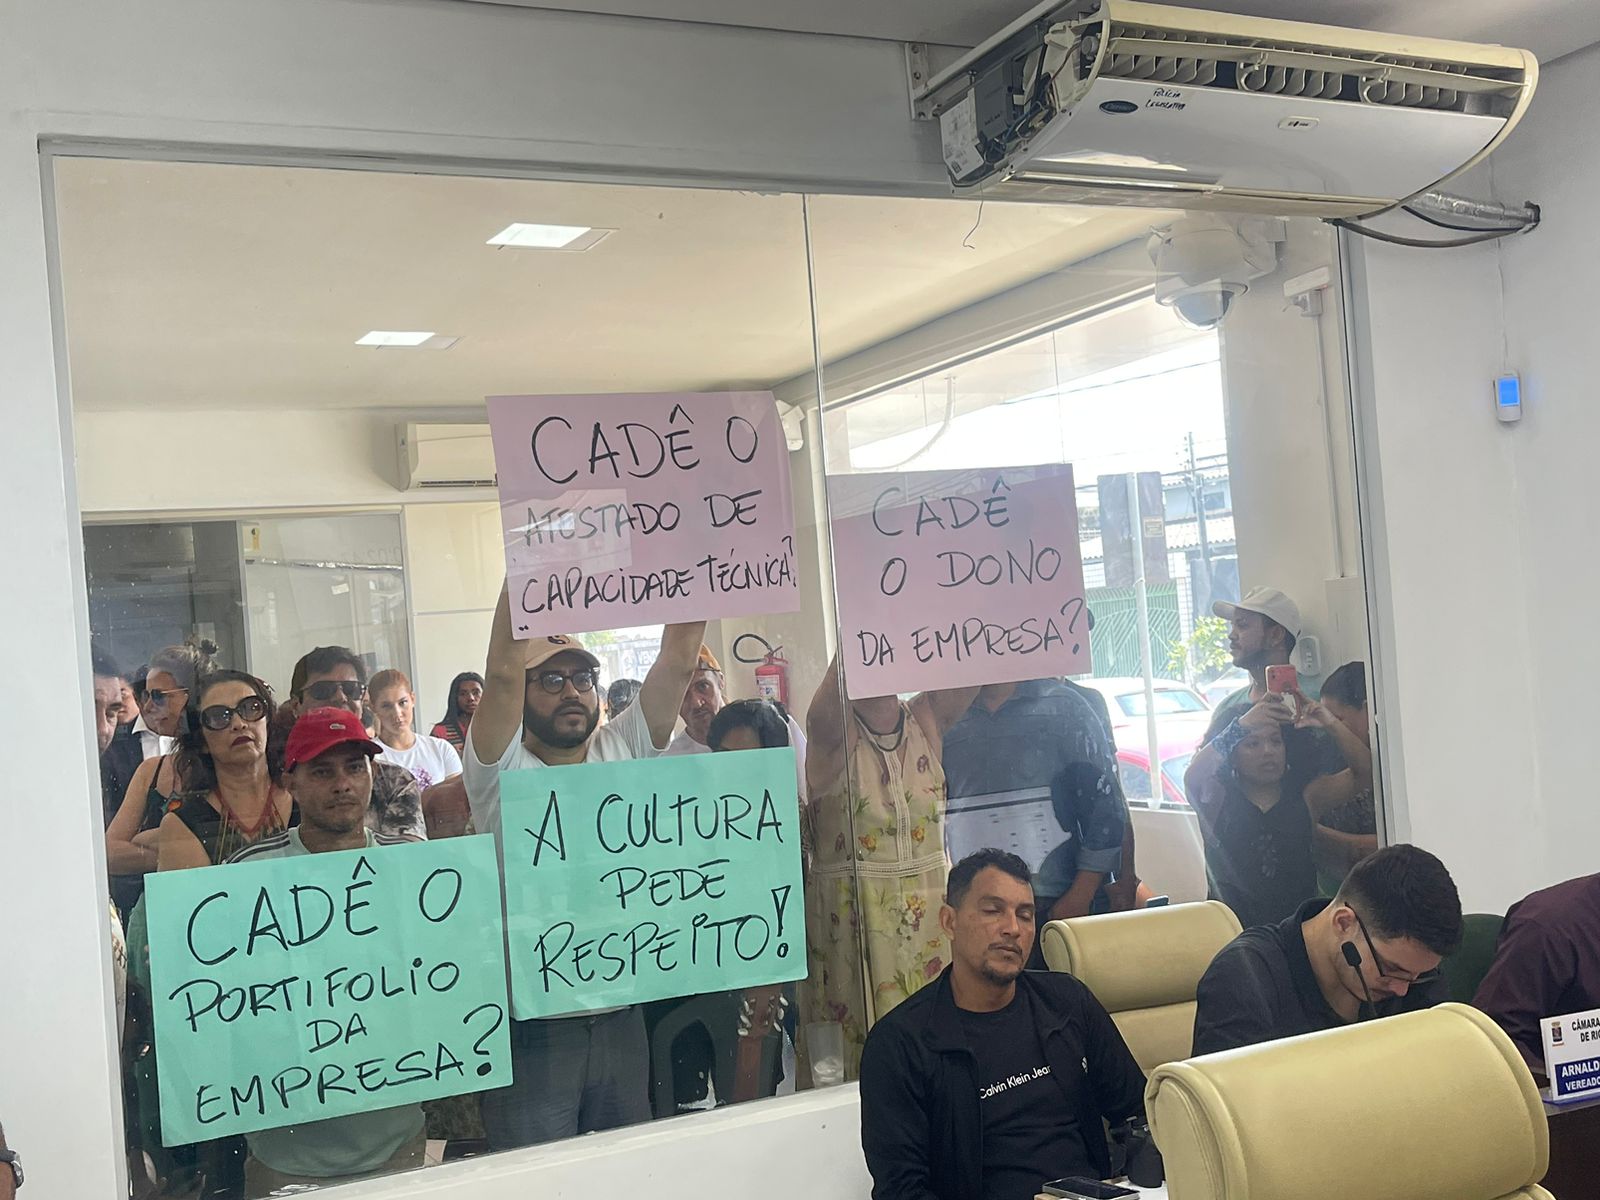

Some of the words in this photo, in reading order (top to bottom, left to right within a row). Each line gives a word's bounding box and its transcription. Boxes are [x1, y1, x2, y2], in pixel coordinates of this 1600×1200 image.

[532, 404, 700, 484] CADÊ
[726, 416, 759, 463] O
[525, 502, 681, 547] ATESTADO
[704, 490, 763, 528] DE
[873, 476, 1012, 537] CADÊ
[522, 567, 694, 614] CAPACIDADE
[697, 536, 797, 592] TÉCNICA?
[881, 558, 907, 596] O
[937, 539, 1061, 588] DONO
[857, 630, 894, 666] DA
[911, 598, 1083, 663] EMPRESA?
[524, 790, 566, 866] A
[596, 789, 784, 854] CULTURA
[187, 856, 379, 966] CADÊ
[419, 868, 462, 923] O
[600, 859, 730, 910] PEDE
[169, 957, 460, 1032] PORTIFOLIO
[197, 1003, 503, 1124] EMPRESA?
[306, 1013, 368, 1053] DA
[1580, 1032, 1590, 1042] DE
[980, 1081, 1007, 1099] Calvin
[1007, 1073, 1031, 1089] Klein
[1562, 1060, 1600, 1078] ARNALD
